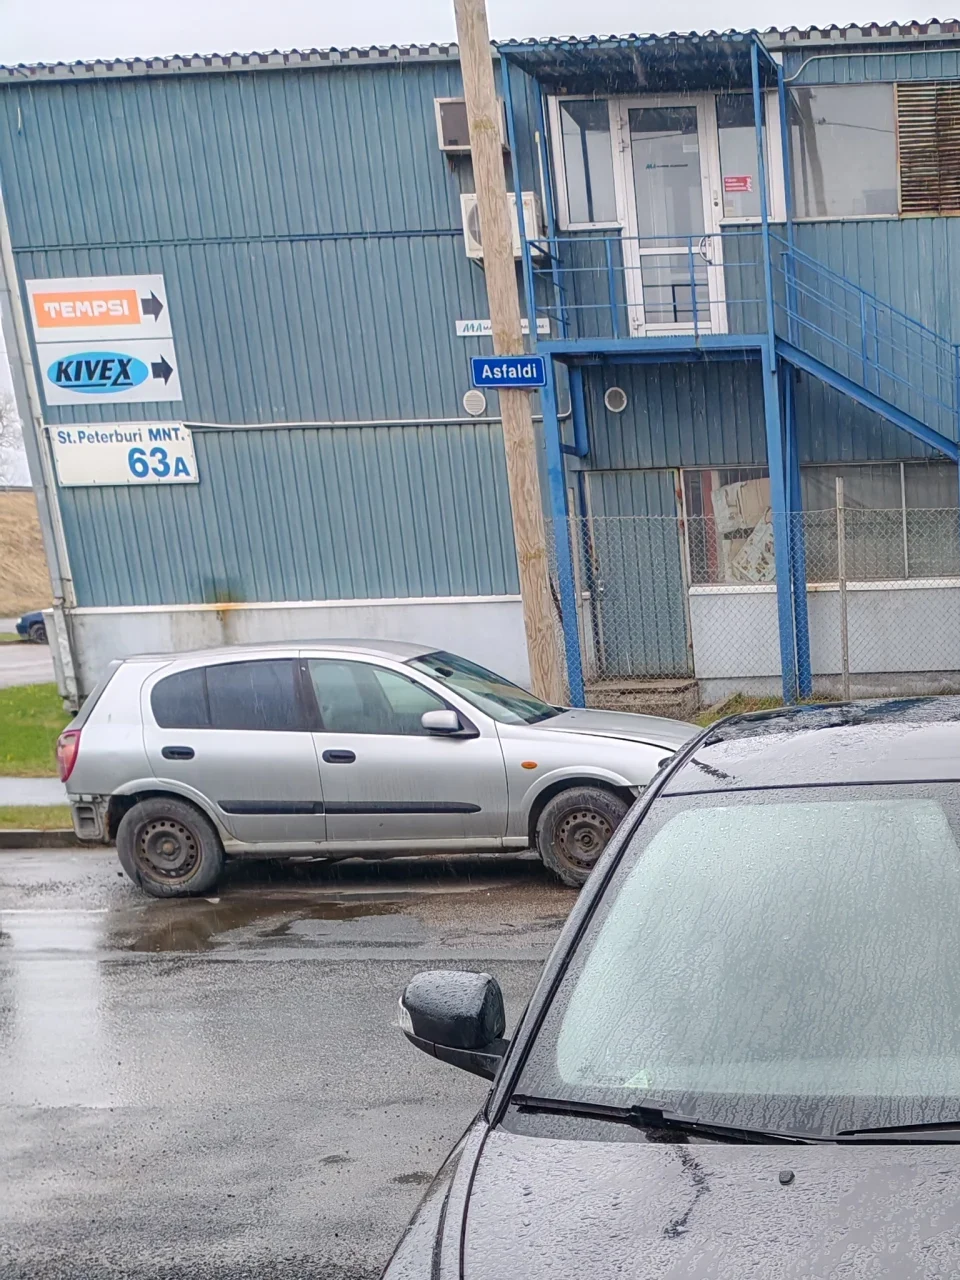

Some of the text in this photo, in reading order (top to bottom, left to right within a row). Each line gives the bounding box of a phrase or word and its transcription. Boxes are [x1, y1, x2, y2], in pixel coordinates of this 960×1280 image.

[44, 300, 129, 318] TEMPSI
[55, 358, 134, 388] KIVEX
[482, 363, 537, 379] Asfaldi
[148, 427, 185, 442] MNT.
[128, 447, 191, 478] 63A
